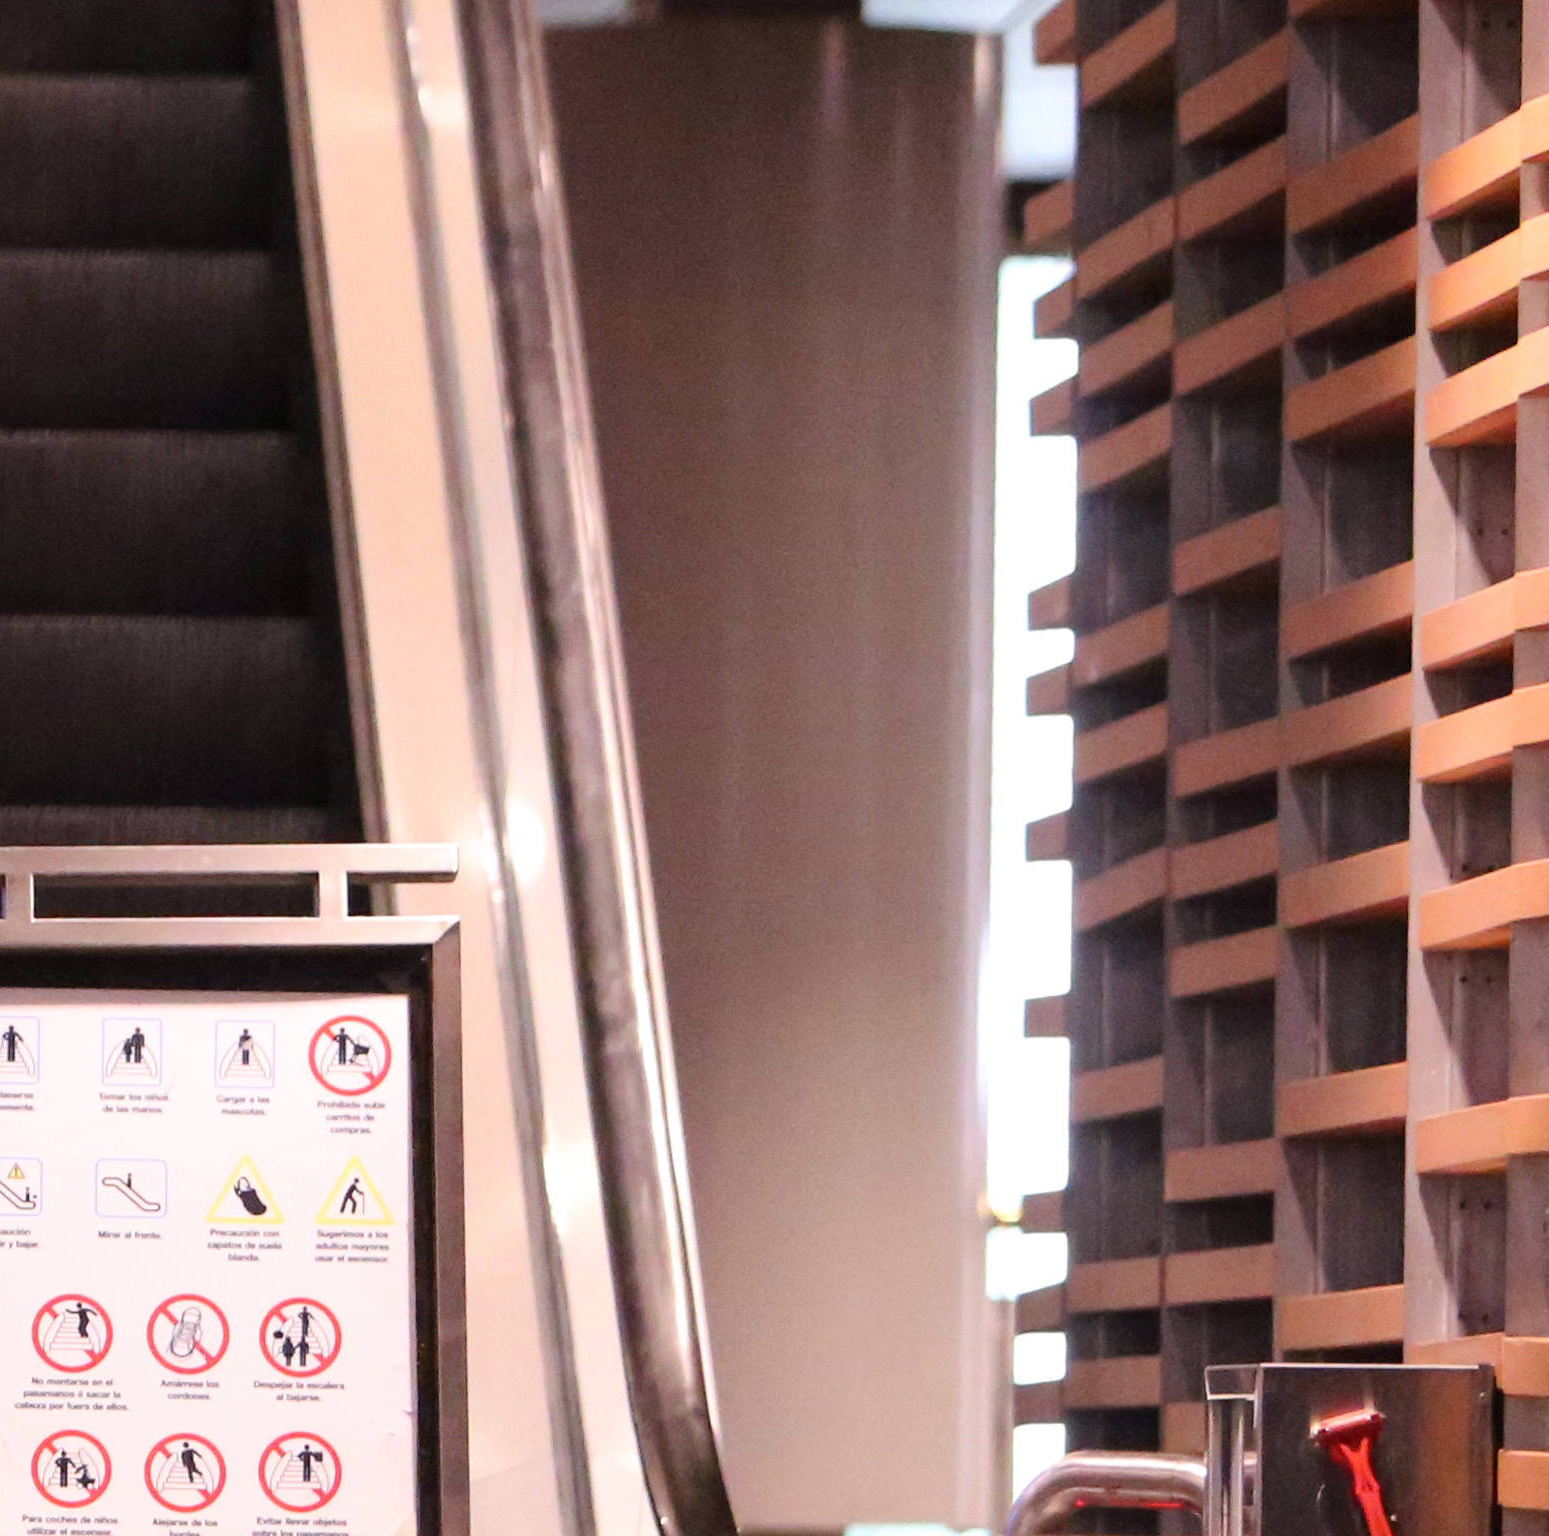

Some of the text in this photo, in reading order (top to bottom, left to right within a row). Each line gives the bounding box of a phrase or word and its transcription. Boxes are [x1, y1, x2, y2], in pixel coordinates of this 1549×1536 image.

[216, 1094, 246, 1105] Cargar
[102, 1104, 114, 1113] de
[363, 1114, 375, 1122] de
[245, 1241, 256, 1250] de
[31, 1377, 44, 1385] No
[22, 1514, 42, 1523] Para
[45, 1515, 78, 1524] coches
[80, 1516, 91, 1524] de
[191, 1518, 202, 1527] de
